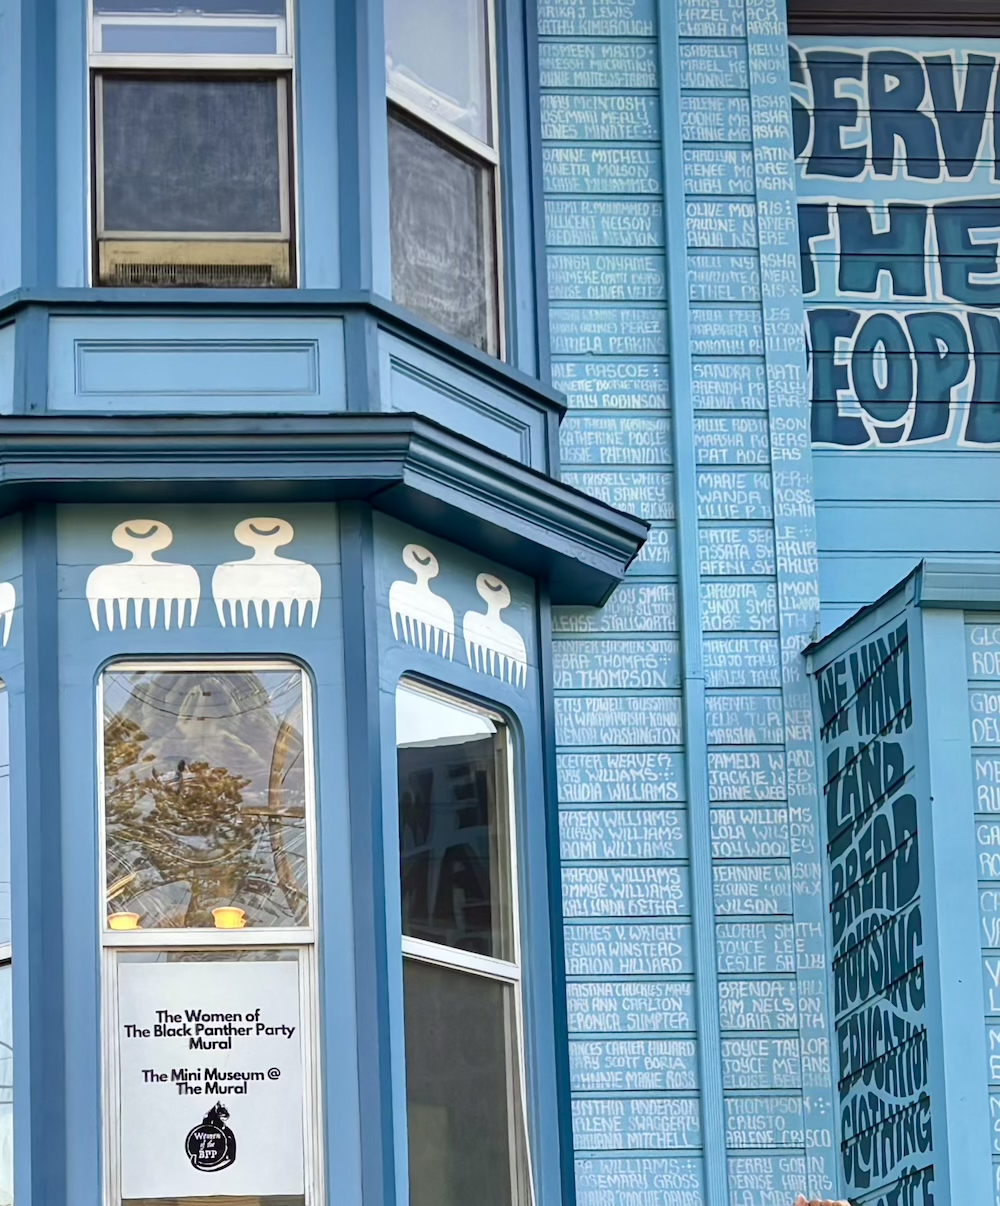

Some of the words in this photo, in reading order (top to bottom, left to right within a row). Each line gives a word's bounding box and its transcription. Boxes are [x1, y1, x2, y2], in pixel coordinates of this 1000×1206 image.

[593, 6, 633, 18] LEWIS
[679, 8, 728, 22] HAZEL
[732, 8, 777, 22] MACK
[681, 59, 723, 73] MABEL
[740, 72, 776, 87] KING
[741, 146, 793, 164] MARTIN
[685, 164, 726, 177] RENEE
[734, 163, 788, 177] MOORE
[685, 179, 722, 193] RUBY
[687, 203, 723, 217] OLIVE
[729, 201, 783, 217] MORRIS
[687, 218, 736, 232] PAULINE
[691, 286, 736, 300] ETHEL
[693, 365, 749, 379] SANDRA
[756, 364, 801, 379] PRATT
[807, 308, 1000, 446] EOPL
[602, 394, 666, 409] ROBINSON
[750, 433, 807, 447] ROGERS
[698, 449, 725, 463] PAT
[736, 448, 801, 463] ROGERS
[699, 473, 745, 489] MARIE
[614, 487, 665, 500] SANKEY
[699, 491, 761, 503] WANDA
[774, 489, 811, 503] ROSS
[699, 545, 748, 559] ASSATA
[756, 541, 817, 559] SHAKUR
[700, 561, 745, 574] AFENI
[752, 557, 818, 574] SHAKUR
[702, 616, 741, 630] ROSE
[750, 613, 806, 630] SMITH
[596, 654, 657, 669] THOMAS
[577, 671, 666, 687] THOMPSON
[818, 657, 851, 745] WE
[850, 619, 913, 737] WANT
[600, 727, 680, 743] WASHINGTON
[607, 754, 672, 769] WEAVER
[708, 753, 760, 769] PAMELA
[769, 750, 814, 769] WARD
[588, 769, 658, 782] WILLIAMS
[710, 786, 751, 799] DIANE
[827, 740, 905, 866] LAND
[740, 807, 811, 825] WILLIAMS
[711, 826, 745, 840] LOLA
[753, 824, 814, 840] WILSON
[712, 843, 742, 857] JOY
[774, 862, 820, 882] WILSON
[830, 794, 920, 947] BREAD
[716, 924, 766, 939] GLORIA
[774, 921, 822, 939] SMITH
[609, 942, 681, 957] WINSTEAD
[718, 941, 763, 955] JOYCE
[774, 938, 805, 954] LEE
[620, 958, 682, 973] HILLIARD
[833, 904, 925, 1017] HOUSING
[720, 981, 784, 997] BRENDA
[720, 999, 744, 1013] KIM
[752, 997, 820, 1012] NELSON
[156, 1010, 183, 1023] The
[184, 1009, 242, 1022] Women
[245, 1008, 261, 1022] of
[720, 1014, 770, 1029] GLORIA
[777, 1013, 824, 1028] SMITH
[124, 1025, 151, 1038] The
[153, 1024, 192, 1037] Black
[195, 1023, 253, 1036] Panther
[256, 1023, 296, 1039] Party
[189, 1037, 232, 1050] Mural
[723, 1041, 769, 1056] JOYCE
[772, 1037, 828, 1056] TAYLOR
[837, 1001, 930, 1098] EDUCATION
[723, 1058, 769, 1073] JOYCE
[772, 1056, 830, 1073] MEANS
[142, 1069, 168, 1083] The
[170, 1068, 201, 1082] Mini
[204, 1068, 265, 1081] Museum
[267, 1067, 281, 1080] @
[176, 1082, 202, 1095] The
[204, 1081, 247, 1095] Mural
[726, 1131, 776, 1145] ARLENE
[783, 1129, 831, 1147] CRISCO
[841, 1093, 933, 1188] CLOTHING
[728, 1158, 772, 1173] TERRY
[654, 1175, 699, 1189] GROSS
